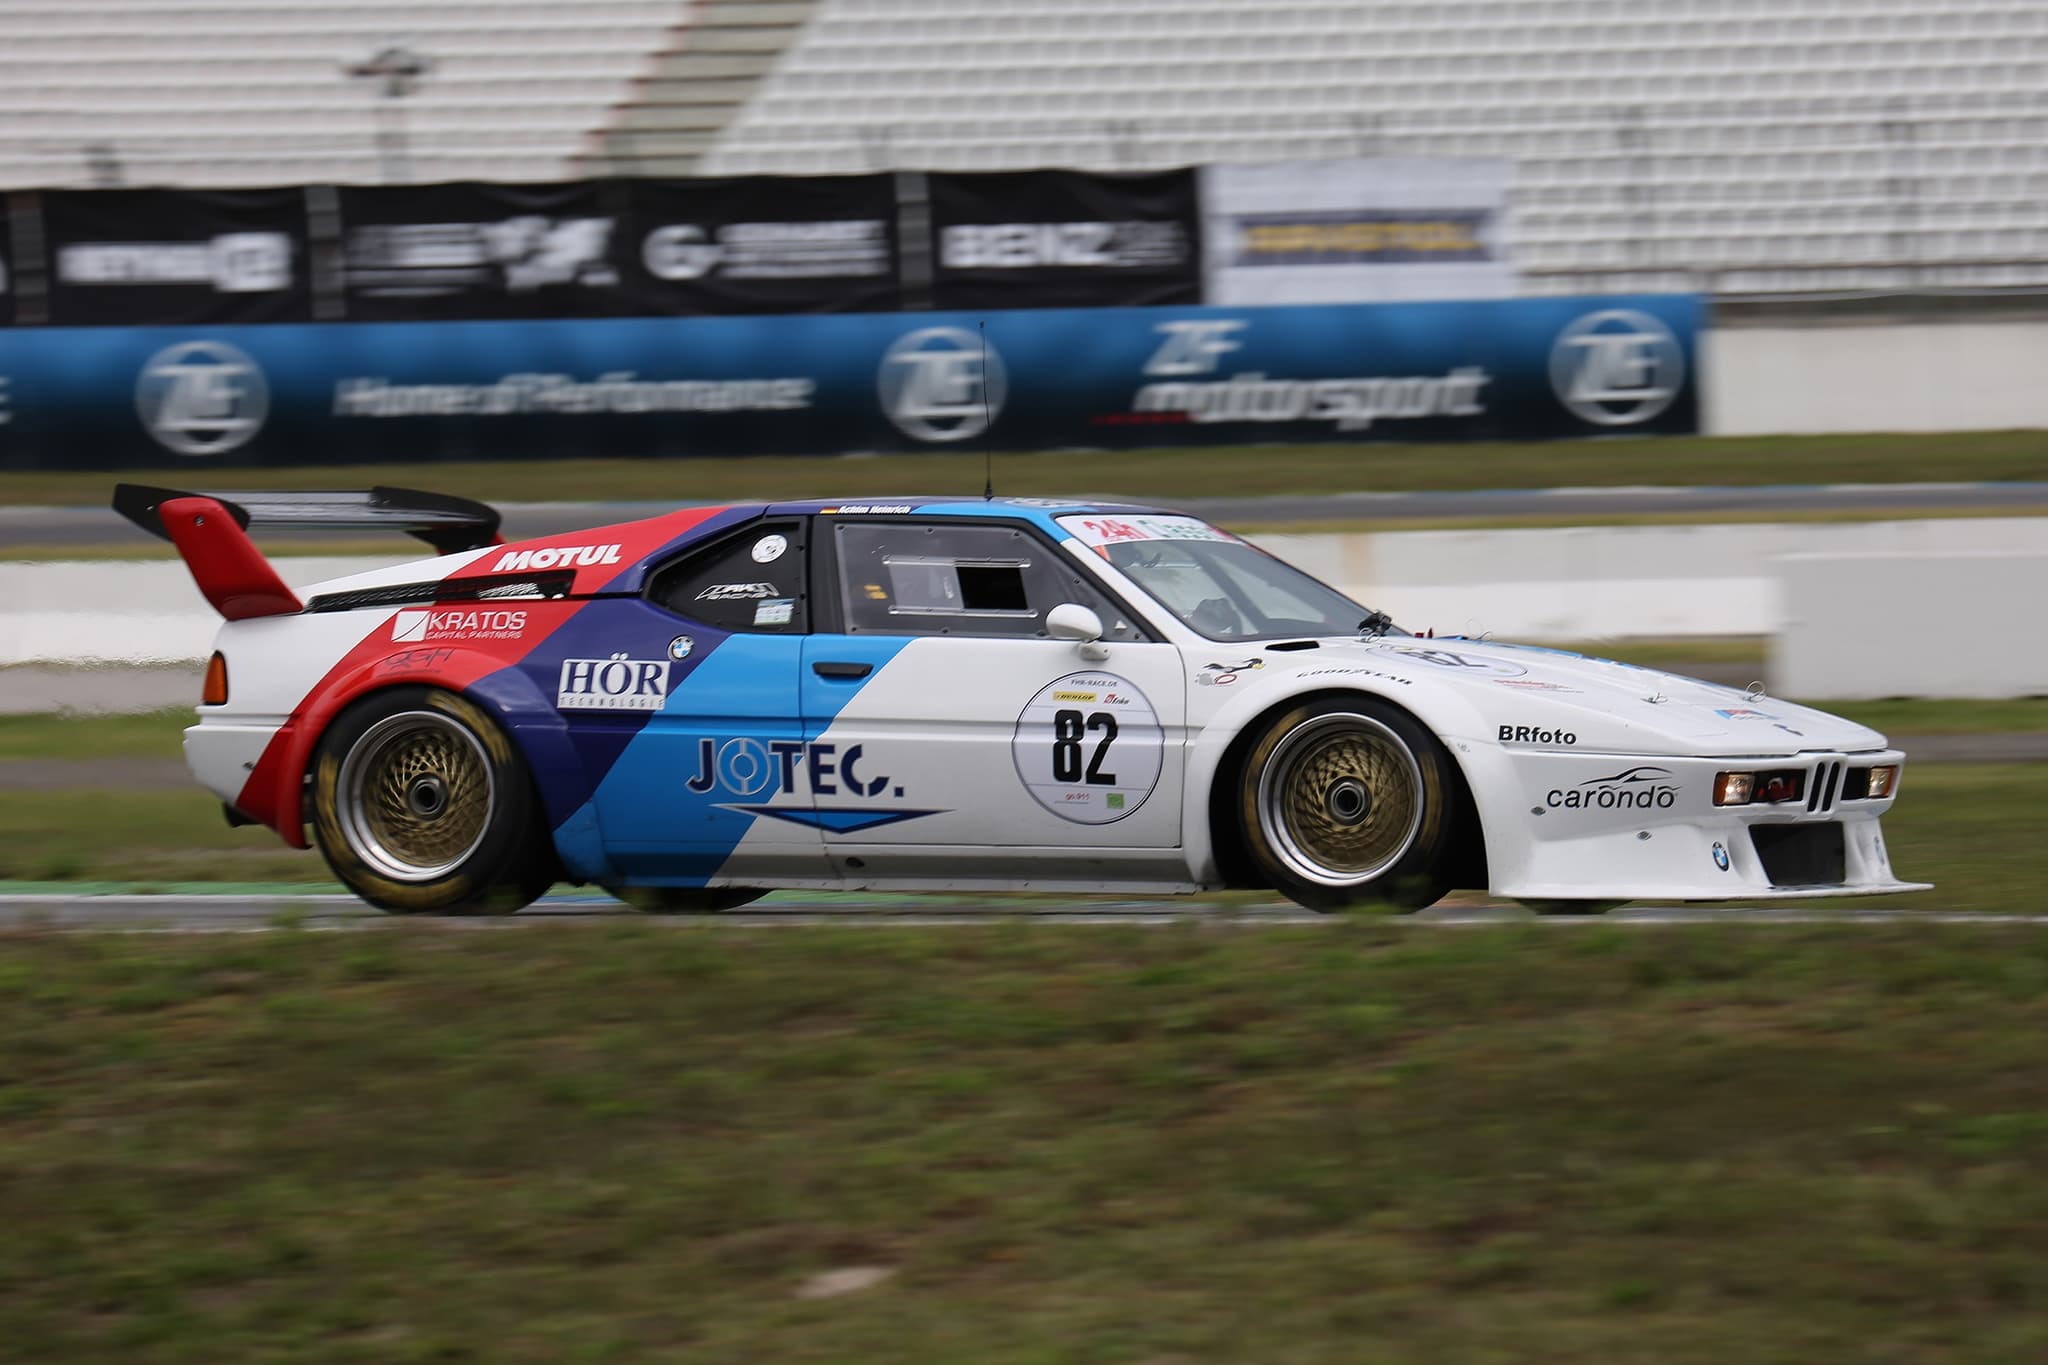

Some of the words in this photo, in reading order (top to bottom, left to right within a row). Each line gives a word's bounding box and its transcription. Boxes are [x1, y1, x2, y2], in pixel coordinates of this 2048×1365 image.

[491, 543, 622, 572] MOTUL
[428, 611, 527, 631] KRATOS
[426, 630, 466, 640] CAPITAL
[467, 630, 523, 640] PARTNERS
[561, 652, 664, 696] HÖR
[1053, 709, 1118, 785] 82
[1498, 725, 1577, 745] BRfoto
